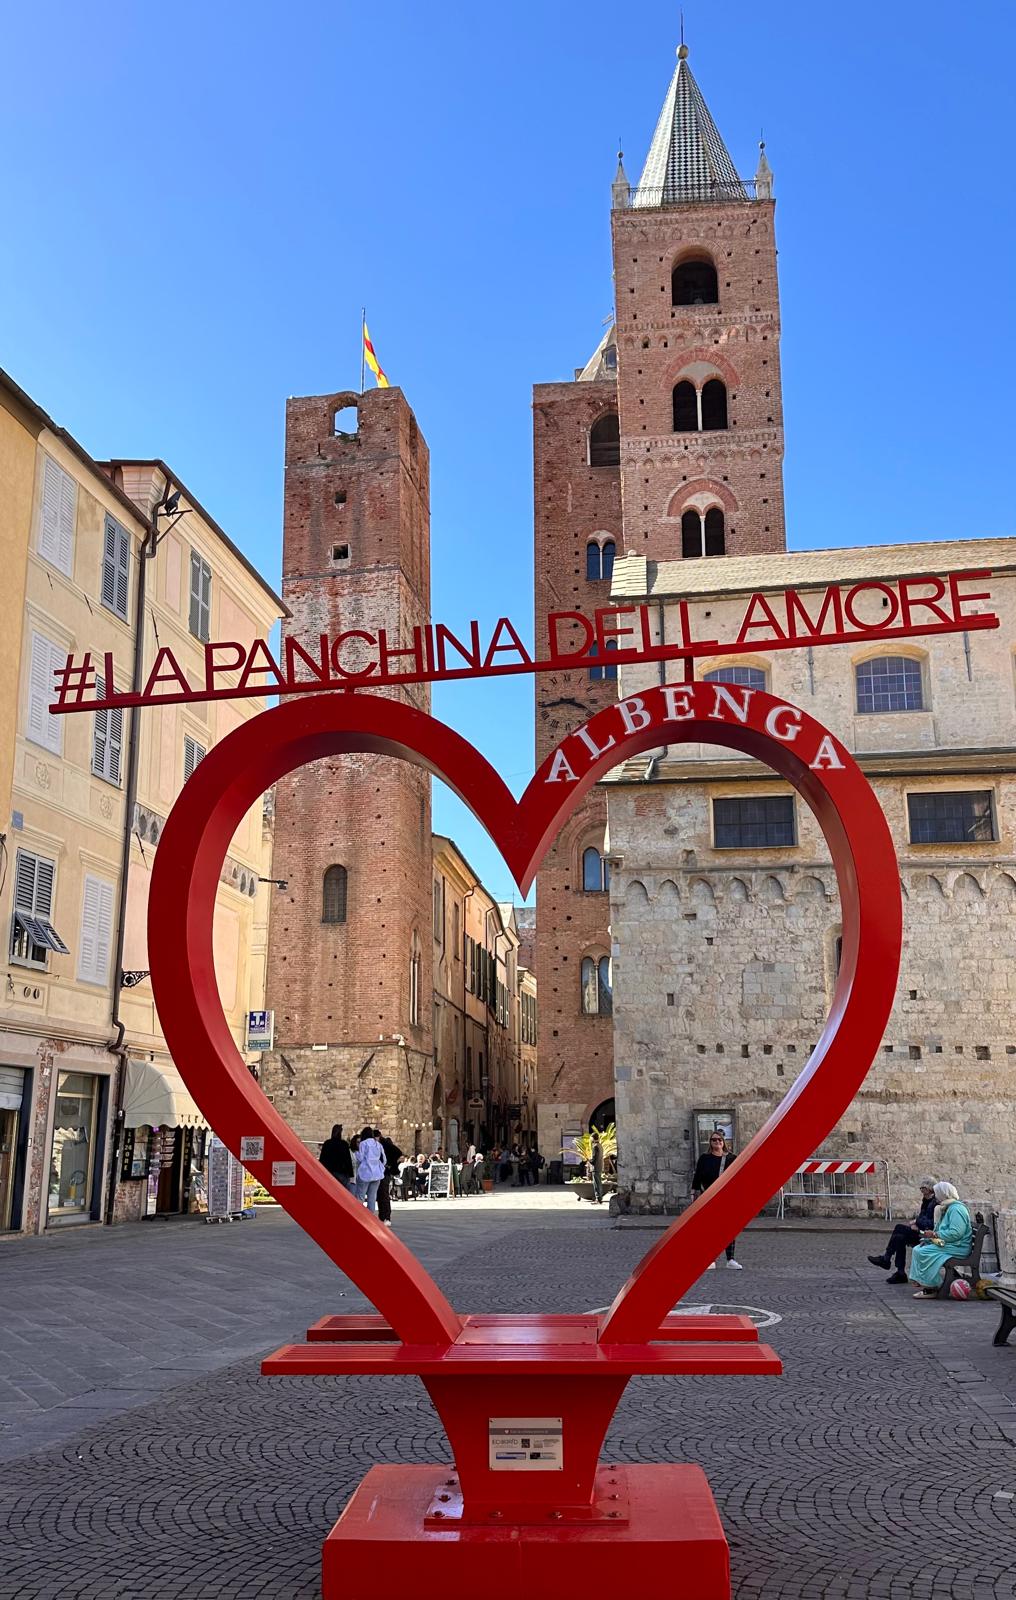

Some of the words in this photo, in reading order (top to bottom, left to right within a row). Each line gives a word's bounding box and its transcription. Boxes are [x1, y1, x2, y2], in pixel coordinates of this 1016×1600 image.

[54, 647, 192, 704] #LA
[204, 617, 533, 692] PANCHINA
[547, 601, 719, 661] DELL
[736, 570, 996, 644] AMORE
[545, 685, 846, 783] ALBENGA
